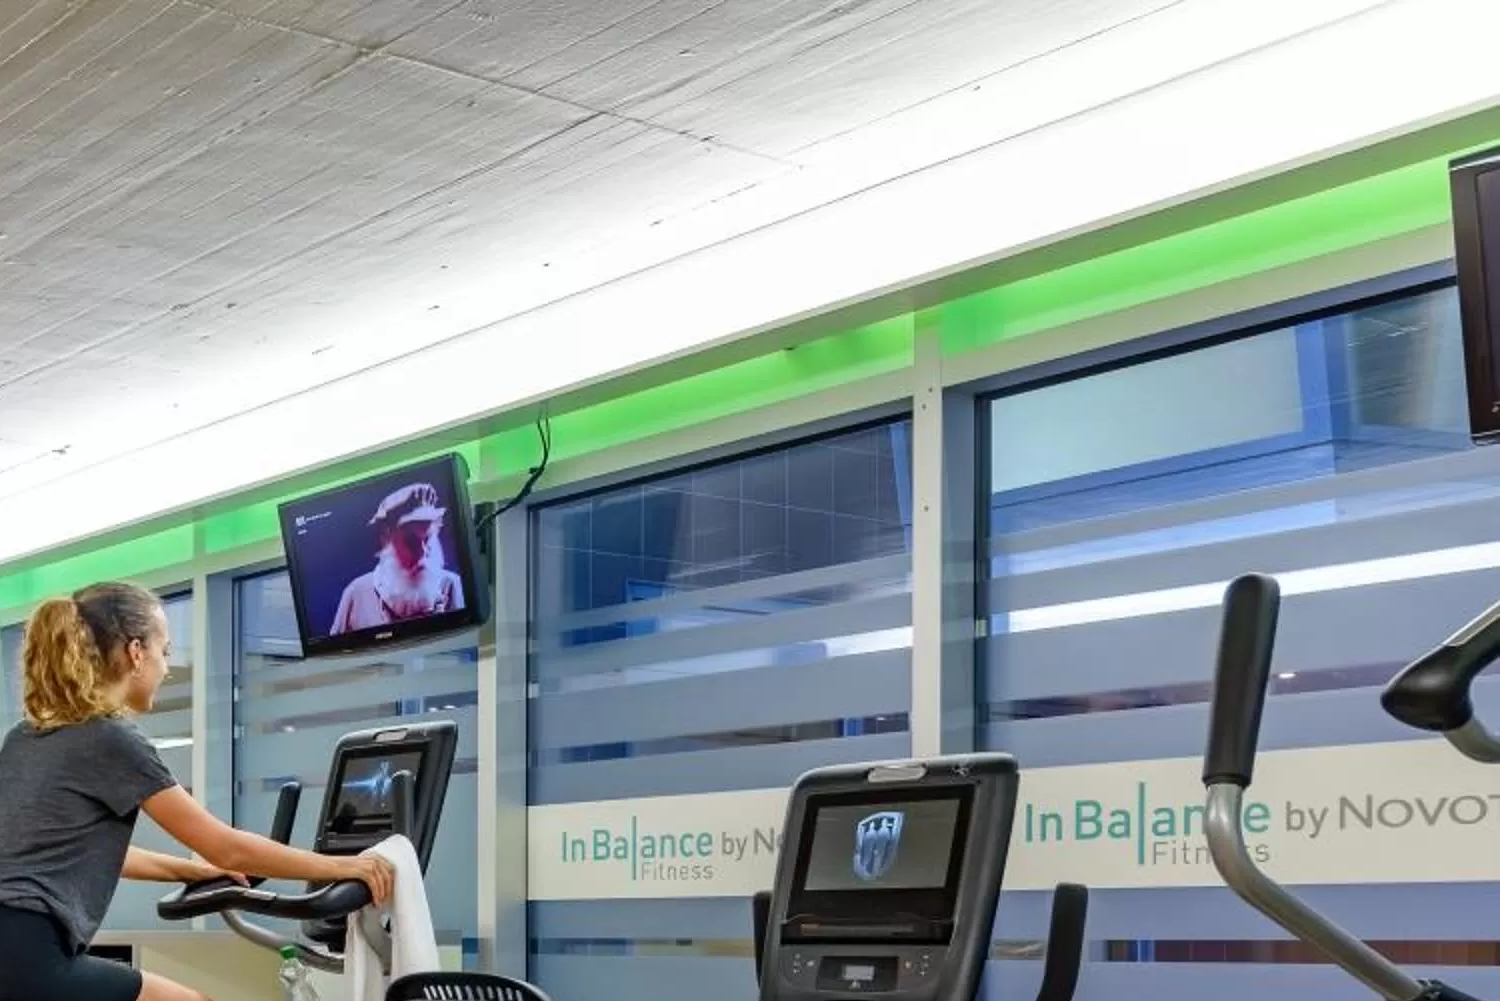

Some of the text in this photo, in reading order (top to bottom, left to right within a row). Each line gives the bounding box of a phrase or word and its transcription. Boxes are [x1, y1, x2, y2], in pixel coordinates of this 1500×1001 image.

[1285, 800, 1329, 839] by
[721, 831, 748, 863] by
[1153, 840, 1270, 865] Fitns
[641, 861, 714, 881] Fitness
